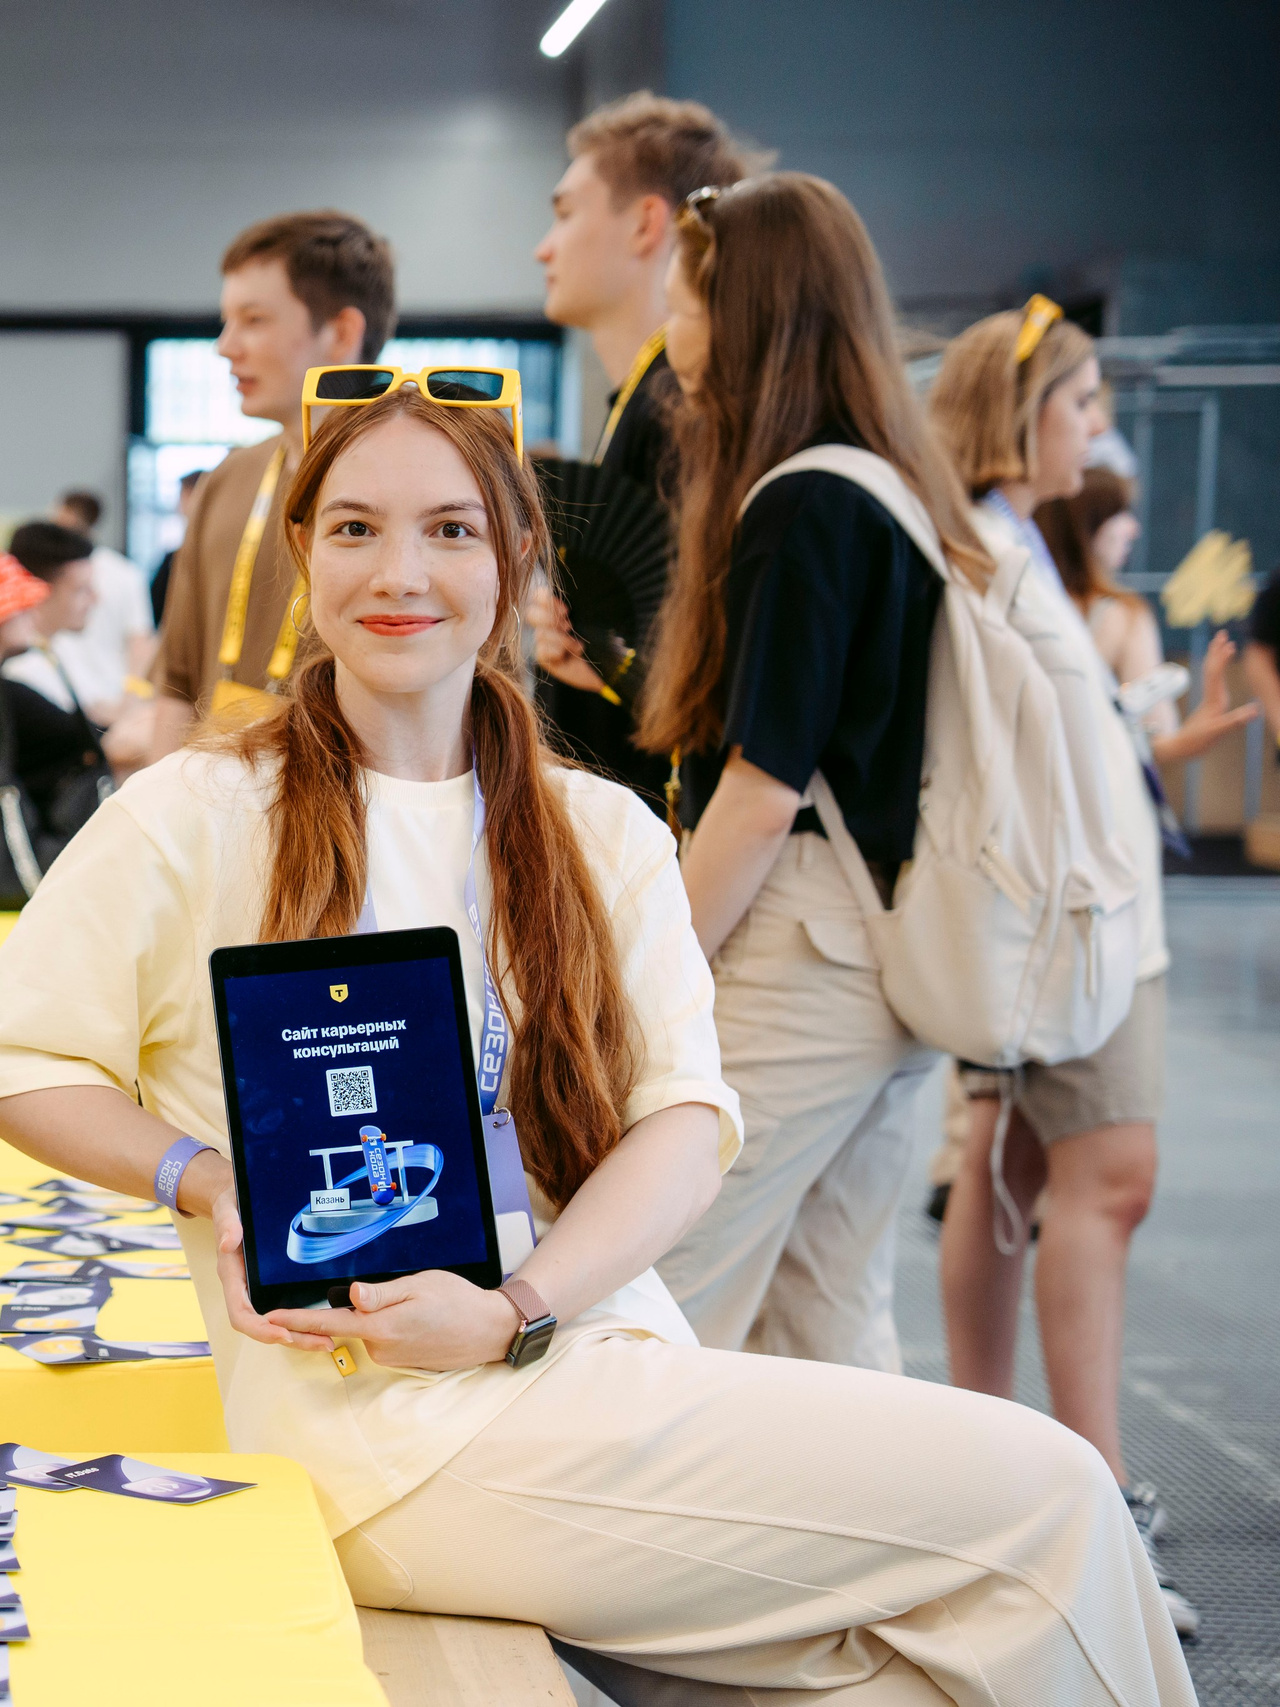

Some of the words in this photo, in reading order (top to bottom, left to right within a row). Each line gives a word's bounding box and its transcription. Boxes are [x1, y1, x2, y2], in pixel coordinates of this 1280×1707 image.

[281, 1026, 319, 1042] Сайт
[320, 1019, 407, 1039] карьерных
[292, 1036, 400, 1059] консультаций
[315, 1196, 345, 1205] Казань
[64, 1466, 100, 1479] IT.Date
